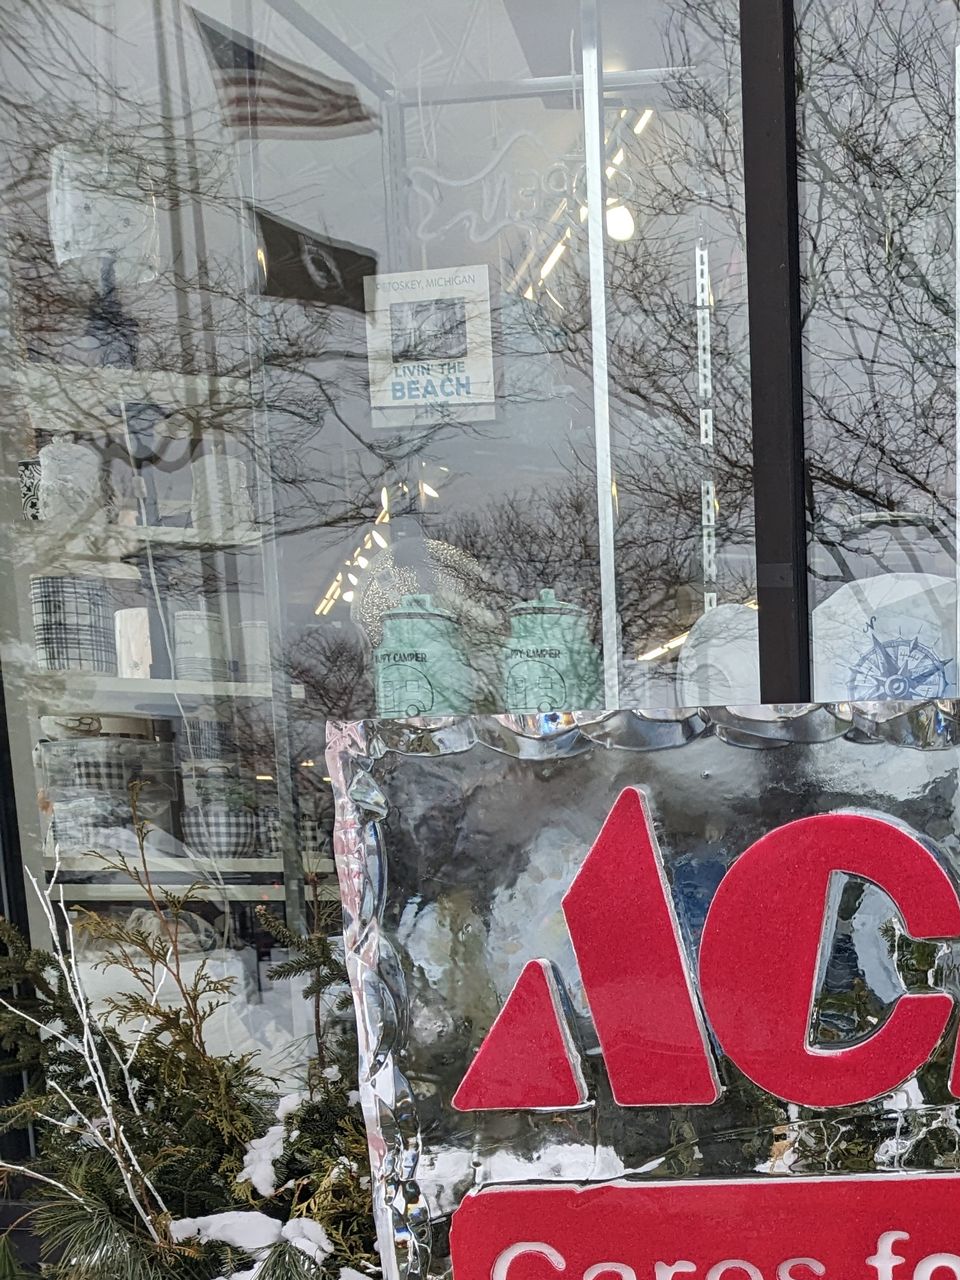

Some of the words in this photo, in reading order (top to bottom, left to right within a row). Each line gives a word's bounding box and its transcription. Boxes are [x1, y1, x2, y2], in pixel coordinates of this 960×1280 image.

[425, 274, 475, 289] MICHIGAN
[394, 362, 434, 378] LIVIN'
[439, 361, 466, 375] THE
[391, 375, 471, 401] BEACH
